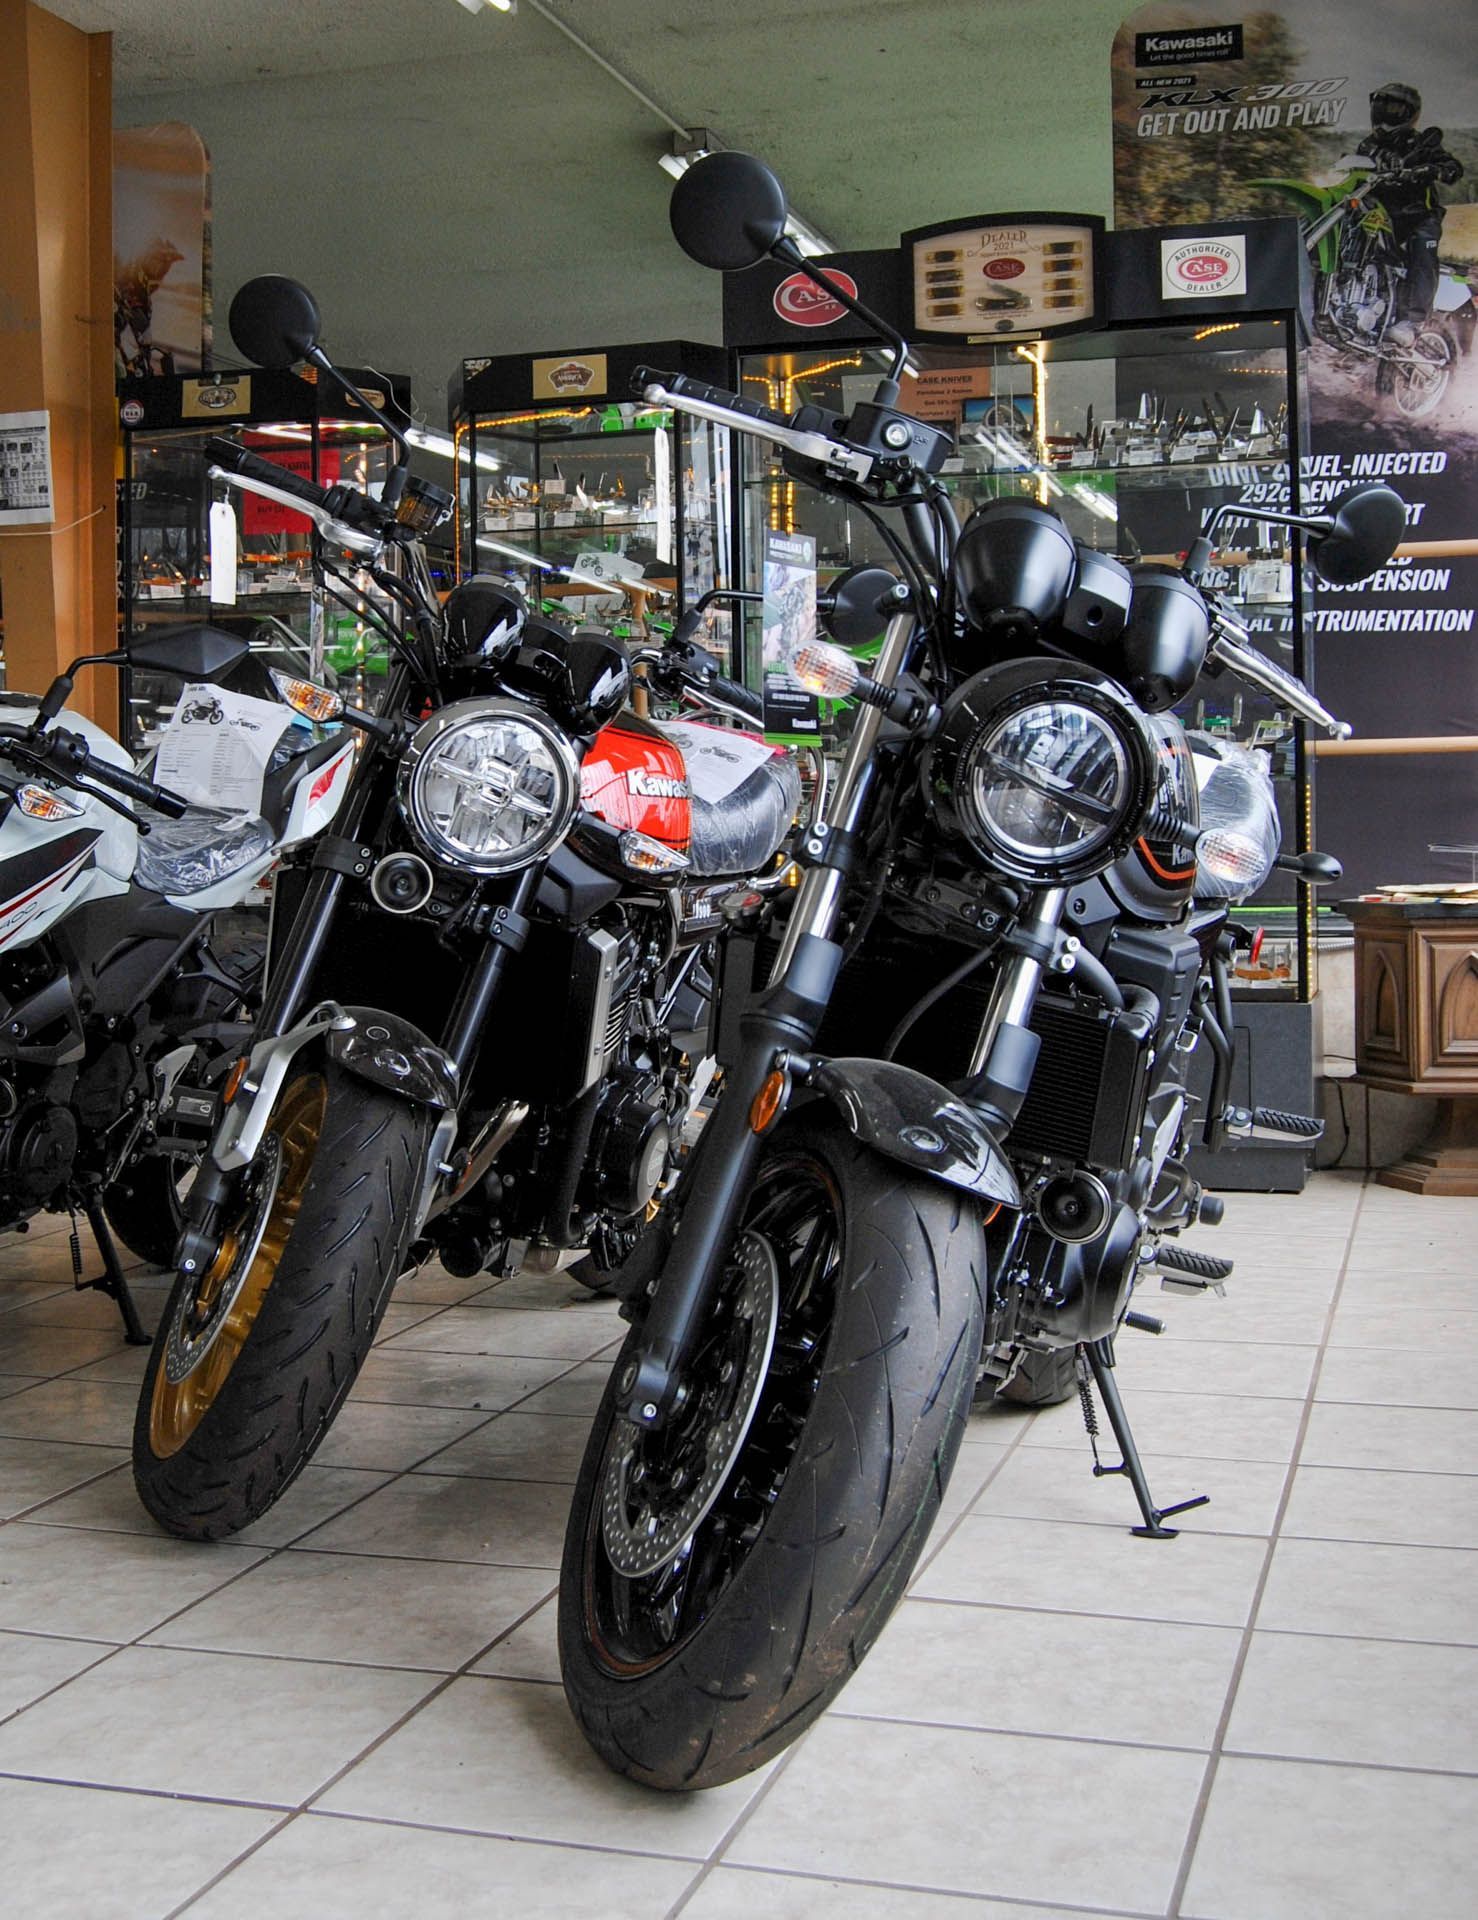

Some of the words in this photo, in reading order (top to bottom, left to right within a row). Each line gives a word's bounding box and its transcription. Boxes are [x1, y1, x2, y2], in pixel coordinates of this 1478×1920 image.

[1145, 31, 1233, 52] Kawasaki
[1138, 86, 1248, 110] KLX
[1247, 77, 1349, 101] 300
[1137, 111, 1181, 136] GET
[1184, 109, 1230, 134] OUT
[1232, 105, 1280, 130] AND
[1286, 98, 1347, 126] PLAY
[1175, 245, 1231, 261] AUTHORIZED
[1180, 259, 1223, 278] CASE
[1187, 282, 1221, 291] DEALER
[1239, 482, 1291, 503] 292c
